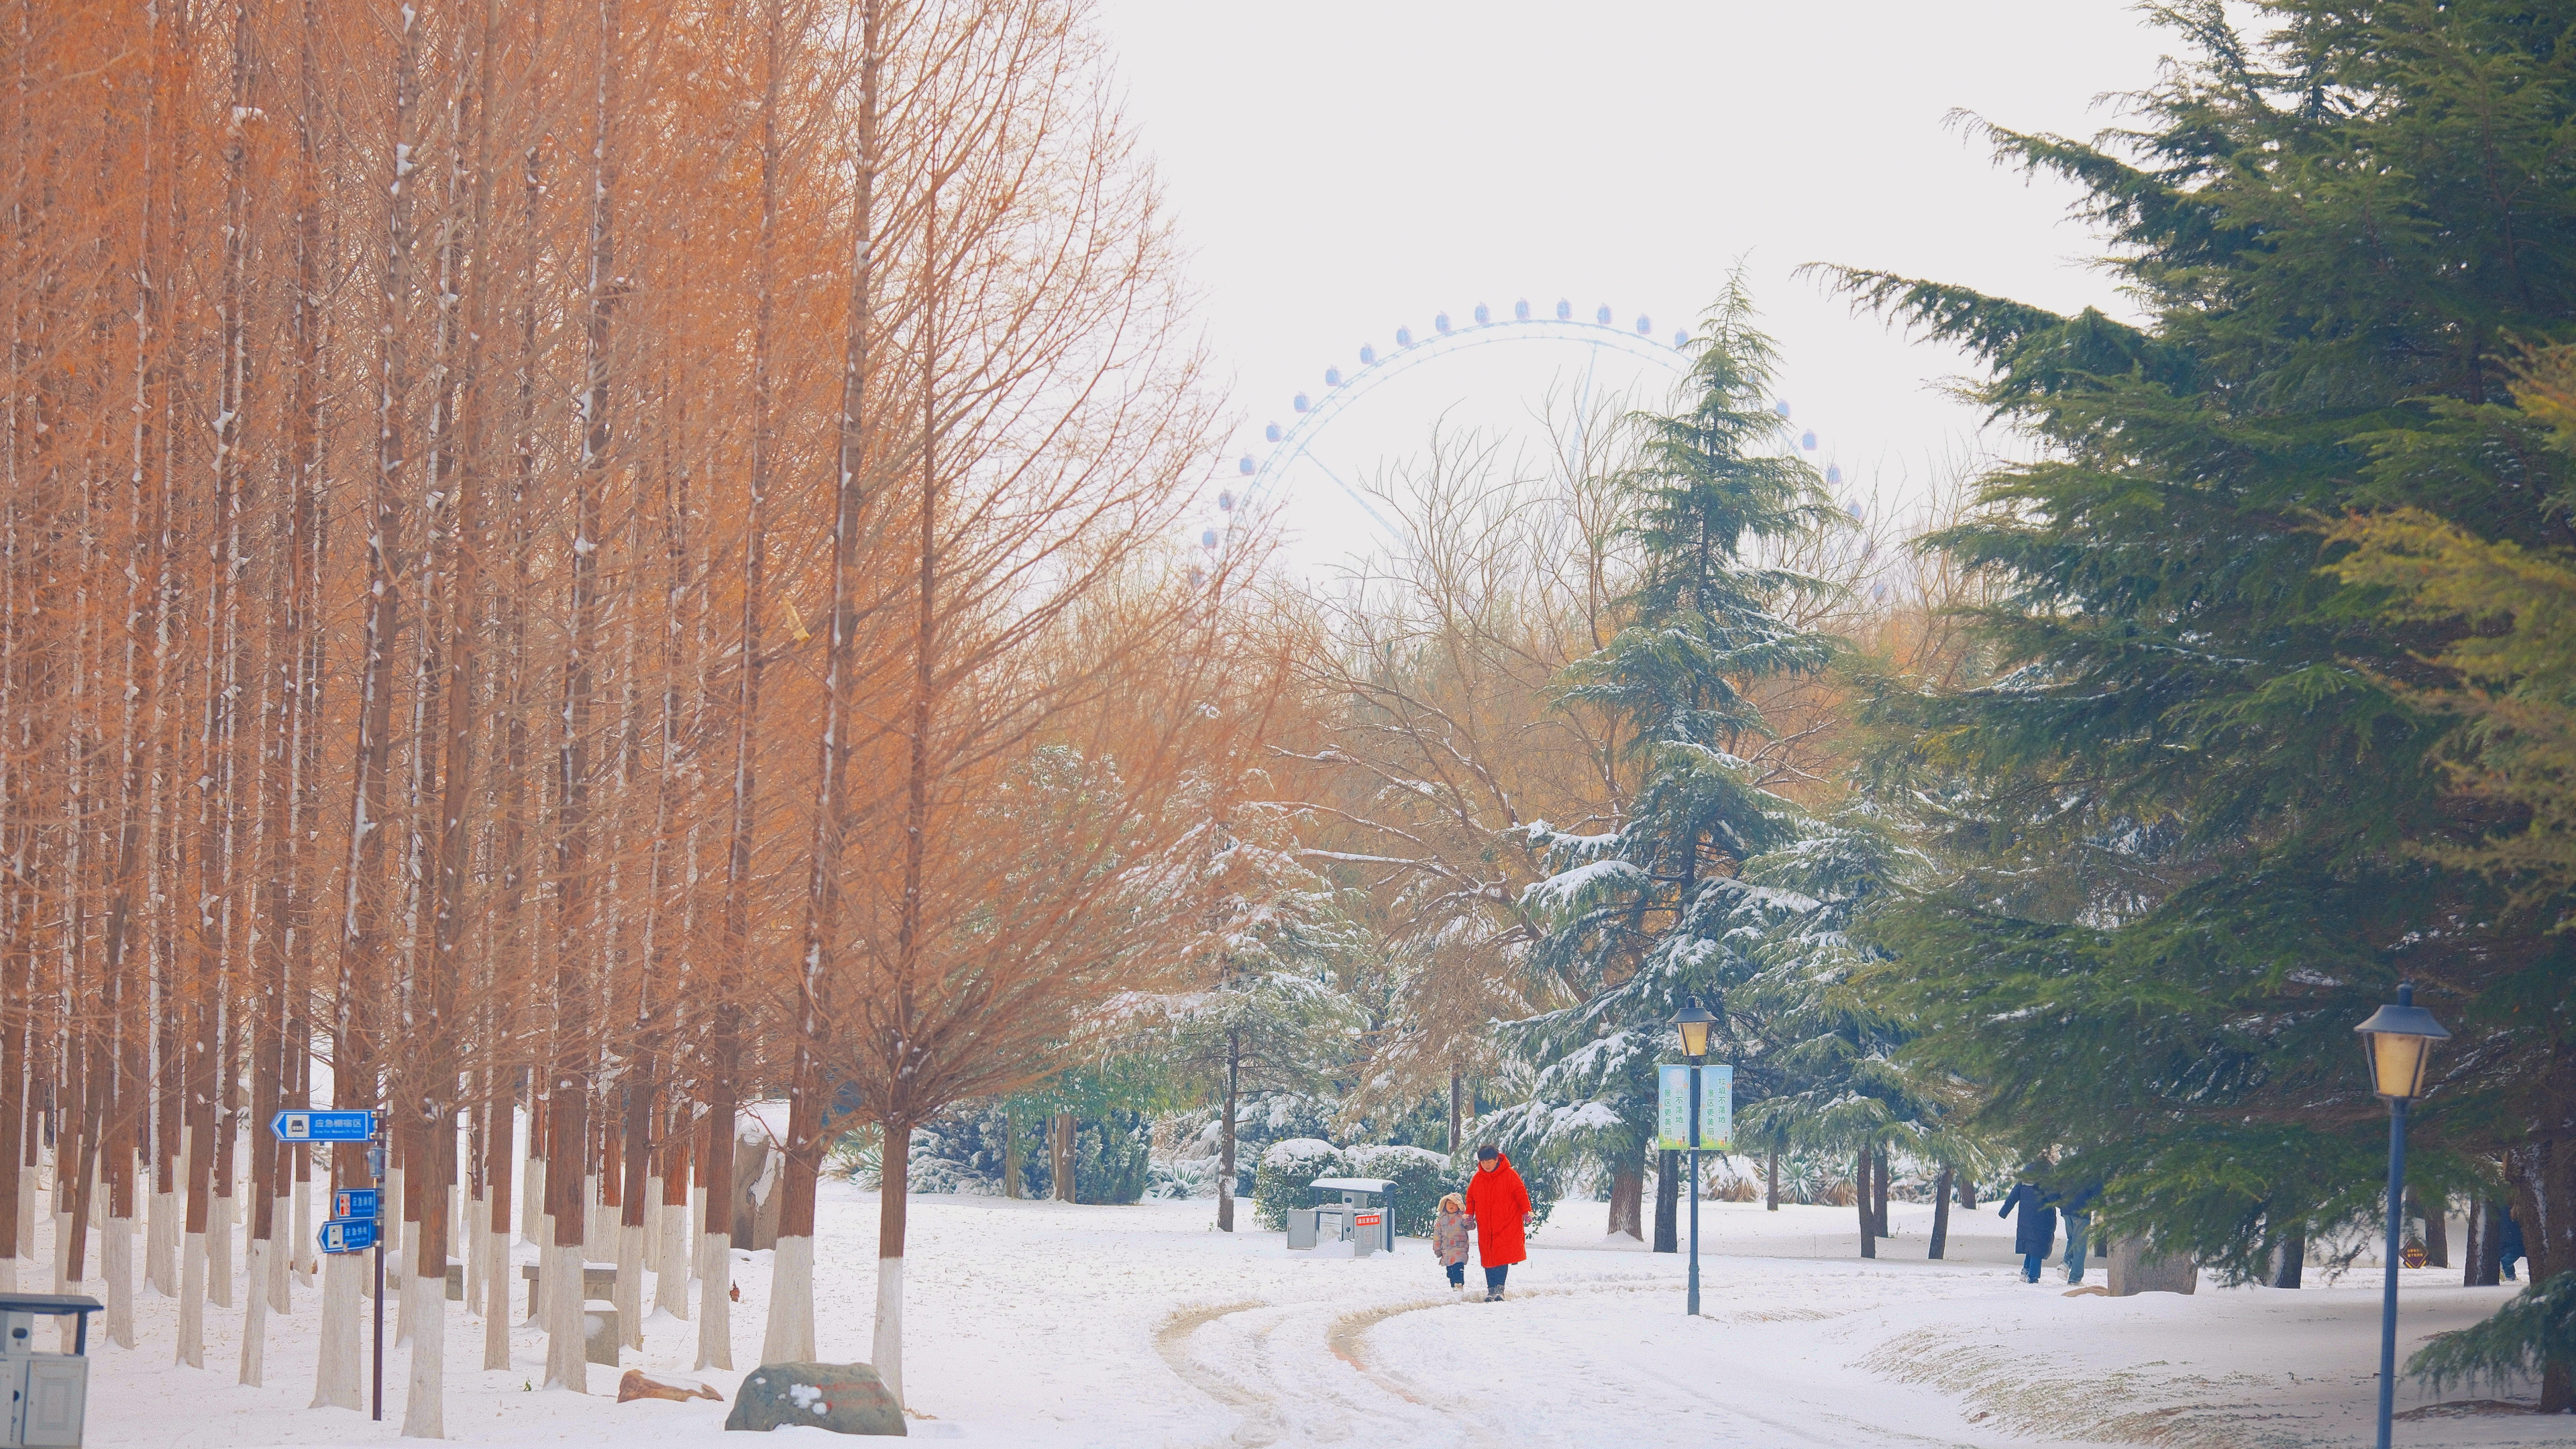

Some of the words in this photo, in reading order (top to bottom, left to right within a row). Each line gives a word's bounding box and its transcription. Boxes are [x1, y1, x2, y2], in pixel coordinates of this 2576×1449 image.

[315, 1119, 362, 1128] 应急棚宿区
[1664, 1089, 1672, 1135] 景区更美丽
[1707, 1089, 1715, 1135] 景区更美丽
[1717, 1077, 1727, 1124] 垃圾不落地
